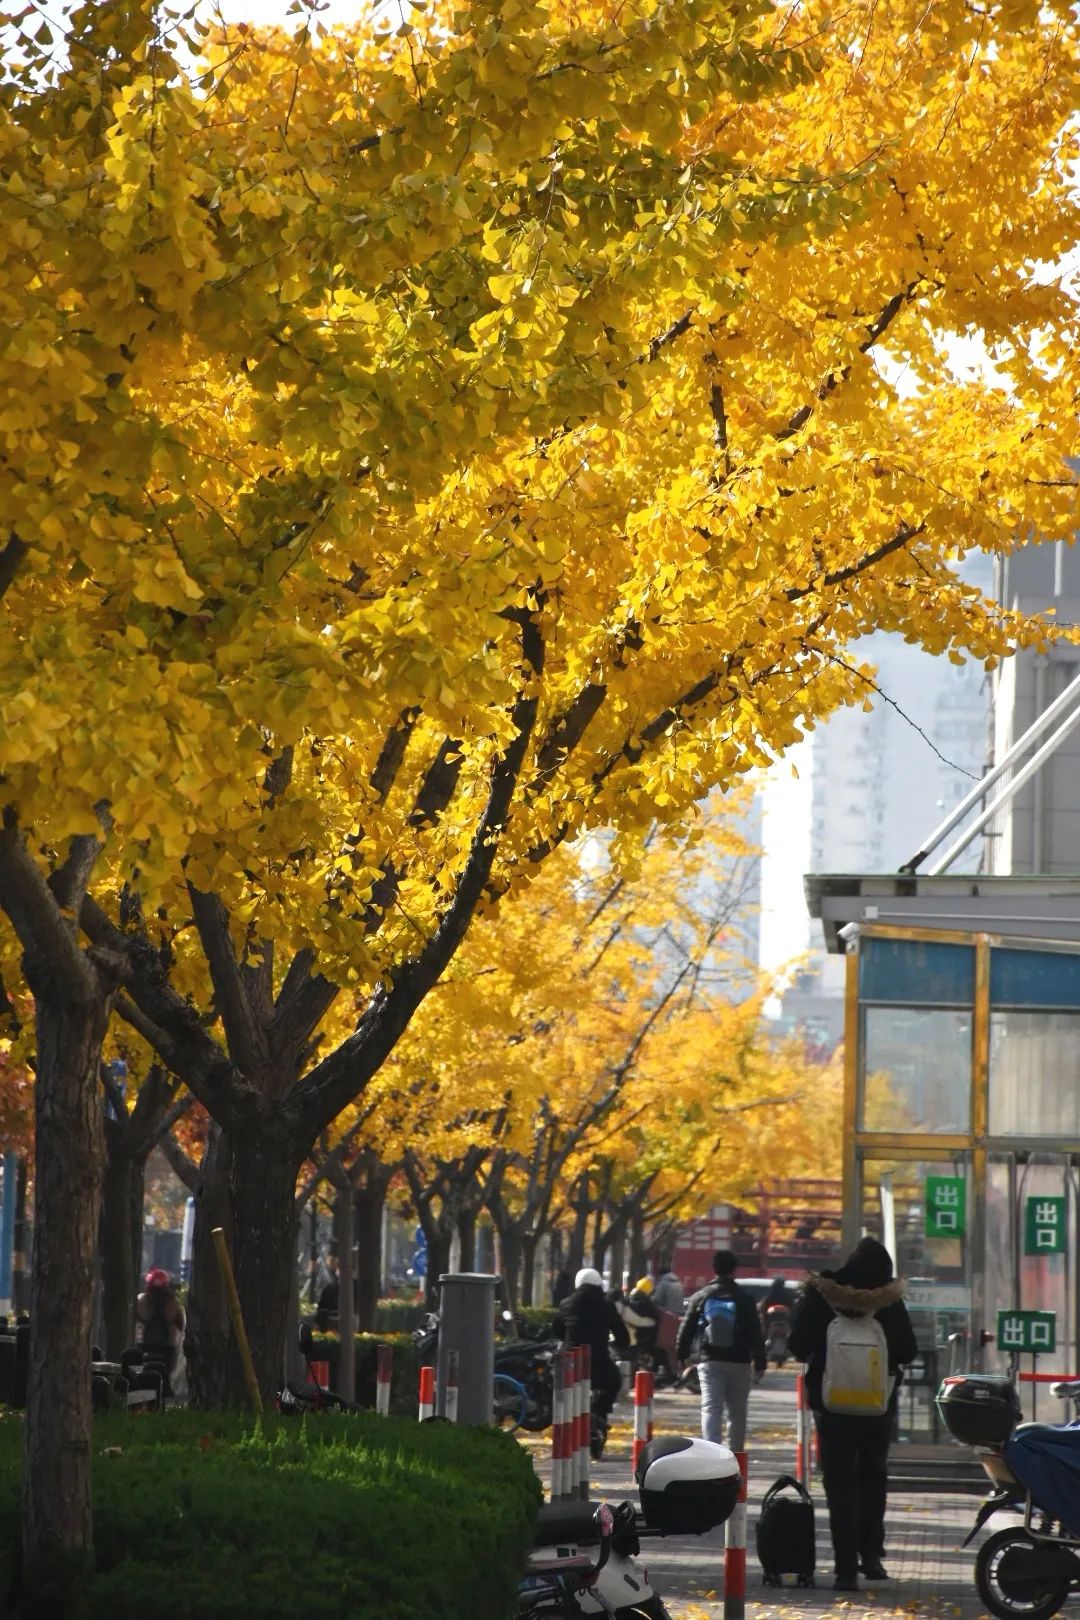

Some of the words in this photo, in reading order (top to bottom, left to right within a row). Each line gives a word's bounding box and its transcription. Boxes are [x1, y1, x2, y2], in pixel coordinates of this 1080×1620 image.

[935, 1184, 958, 1229] 出口
[1036, 1202, 1057, 1247] 出口
[1003, 1317, 1050, 1345] 出口
